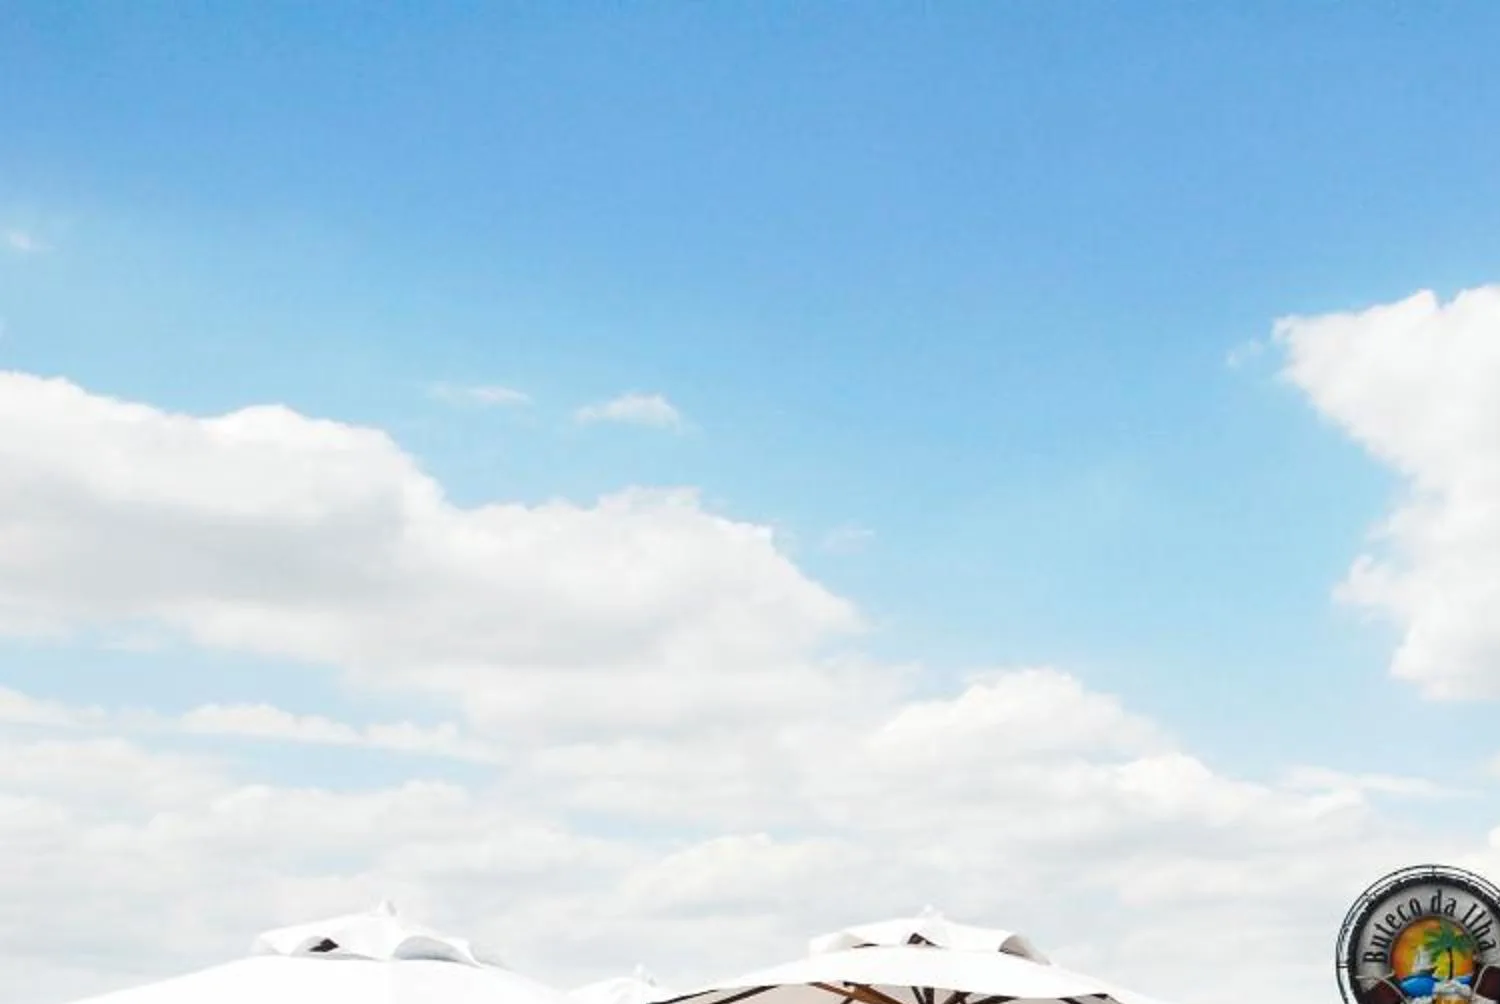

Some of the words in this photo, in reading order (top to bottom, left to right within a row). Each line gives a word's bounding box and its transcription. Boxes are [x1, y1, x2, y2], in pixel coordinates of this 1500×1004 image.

[1363, 898, 1422, 963] Buteco
[1431, 889, 1457, 917] da
[1462, 903, 1497, 952] Ilha
